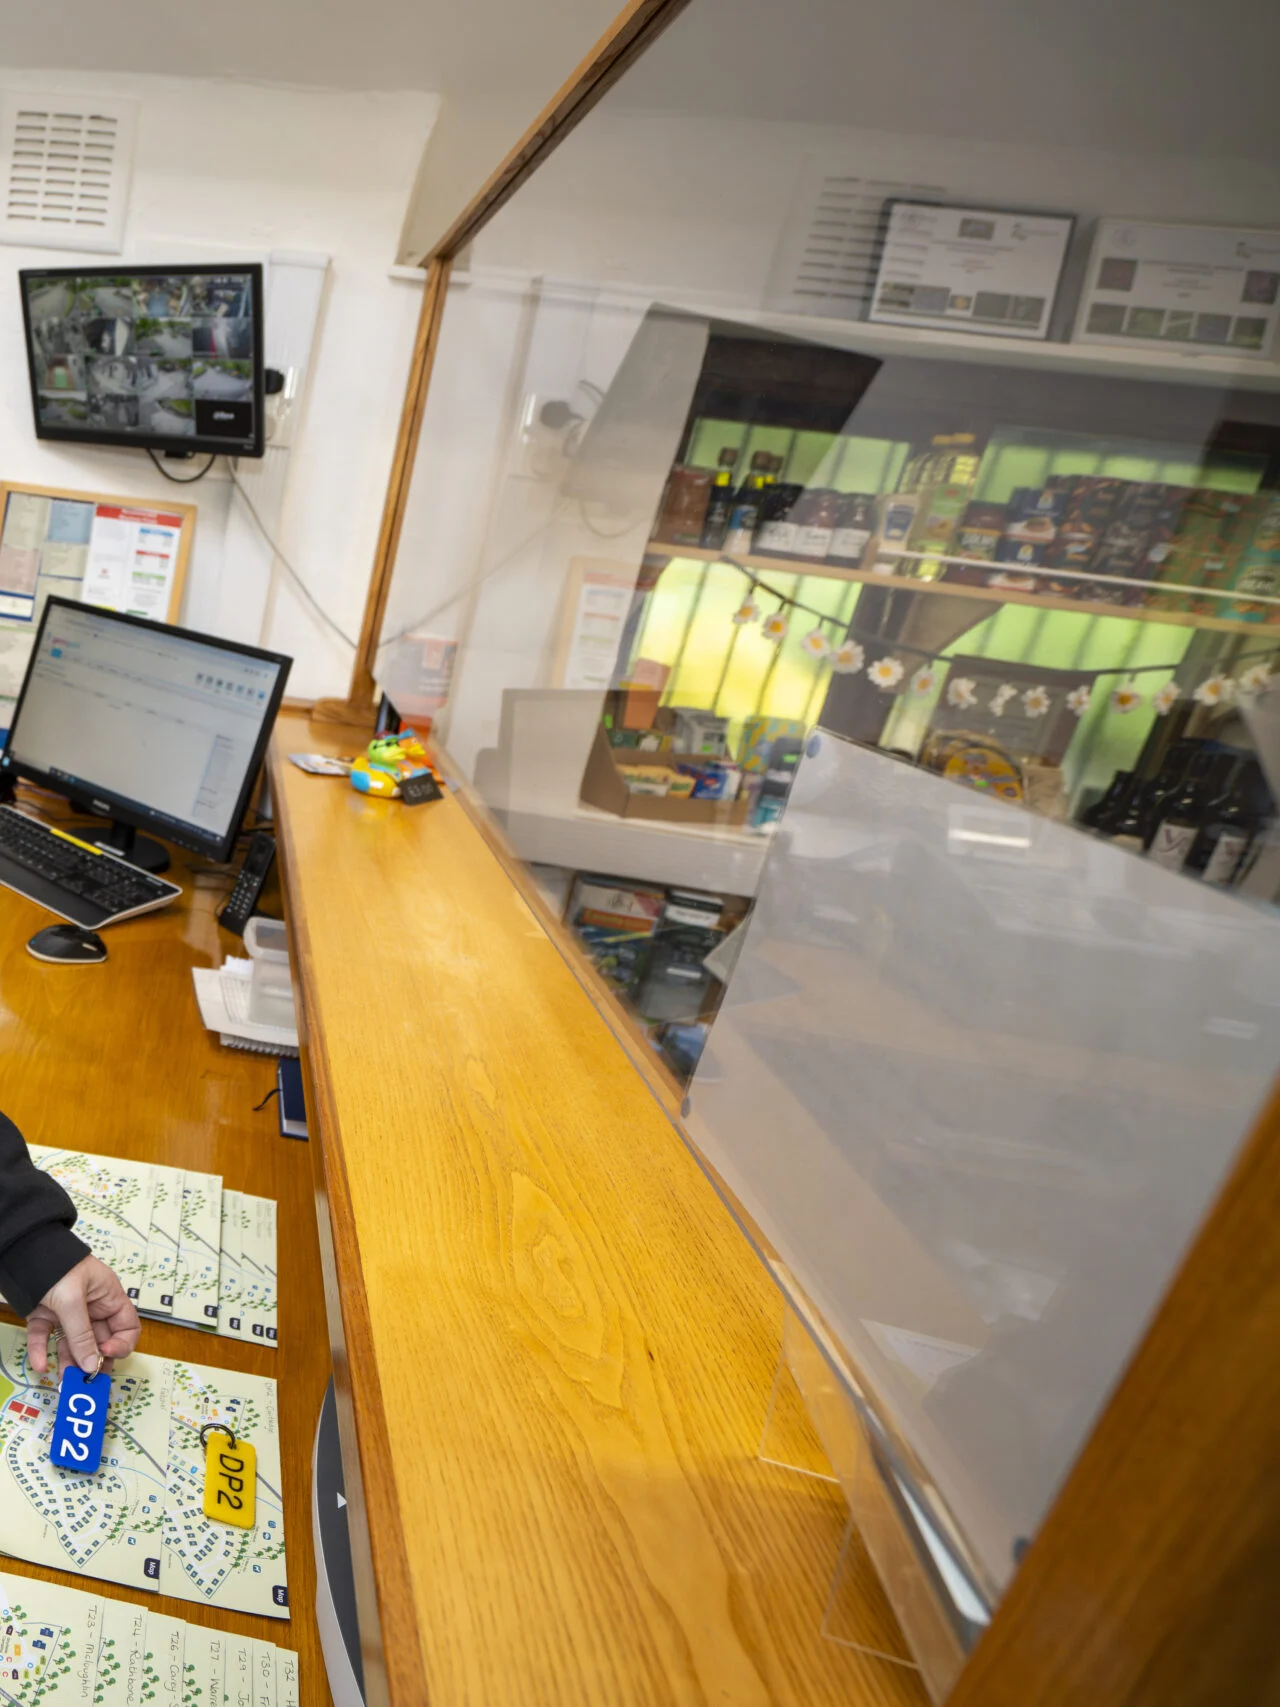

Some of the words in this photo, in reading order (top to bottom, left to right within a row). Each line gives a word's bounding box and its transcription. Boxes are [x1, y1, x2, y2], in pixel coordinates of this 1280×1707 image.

[60, 1393, 96, 1461] CP2
[217, 1453, 244, 1510] DP2
[147, 1561, 156, 1576] Map
[276, 1589, 285, 1603] Map
[87, 1605, 98, 1629] T23
[132, 1614, 142, 1636] T24
[170, 1631, 179, 1651] T26
[210, 1640, 220, 1660] T27
[238, 1648, 247, 1670] T29
[261, 1652, 270, 1677] T30
[284, 1660, 294, 1681] T32
